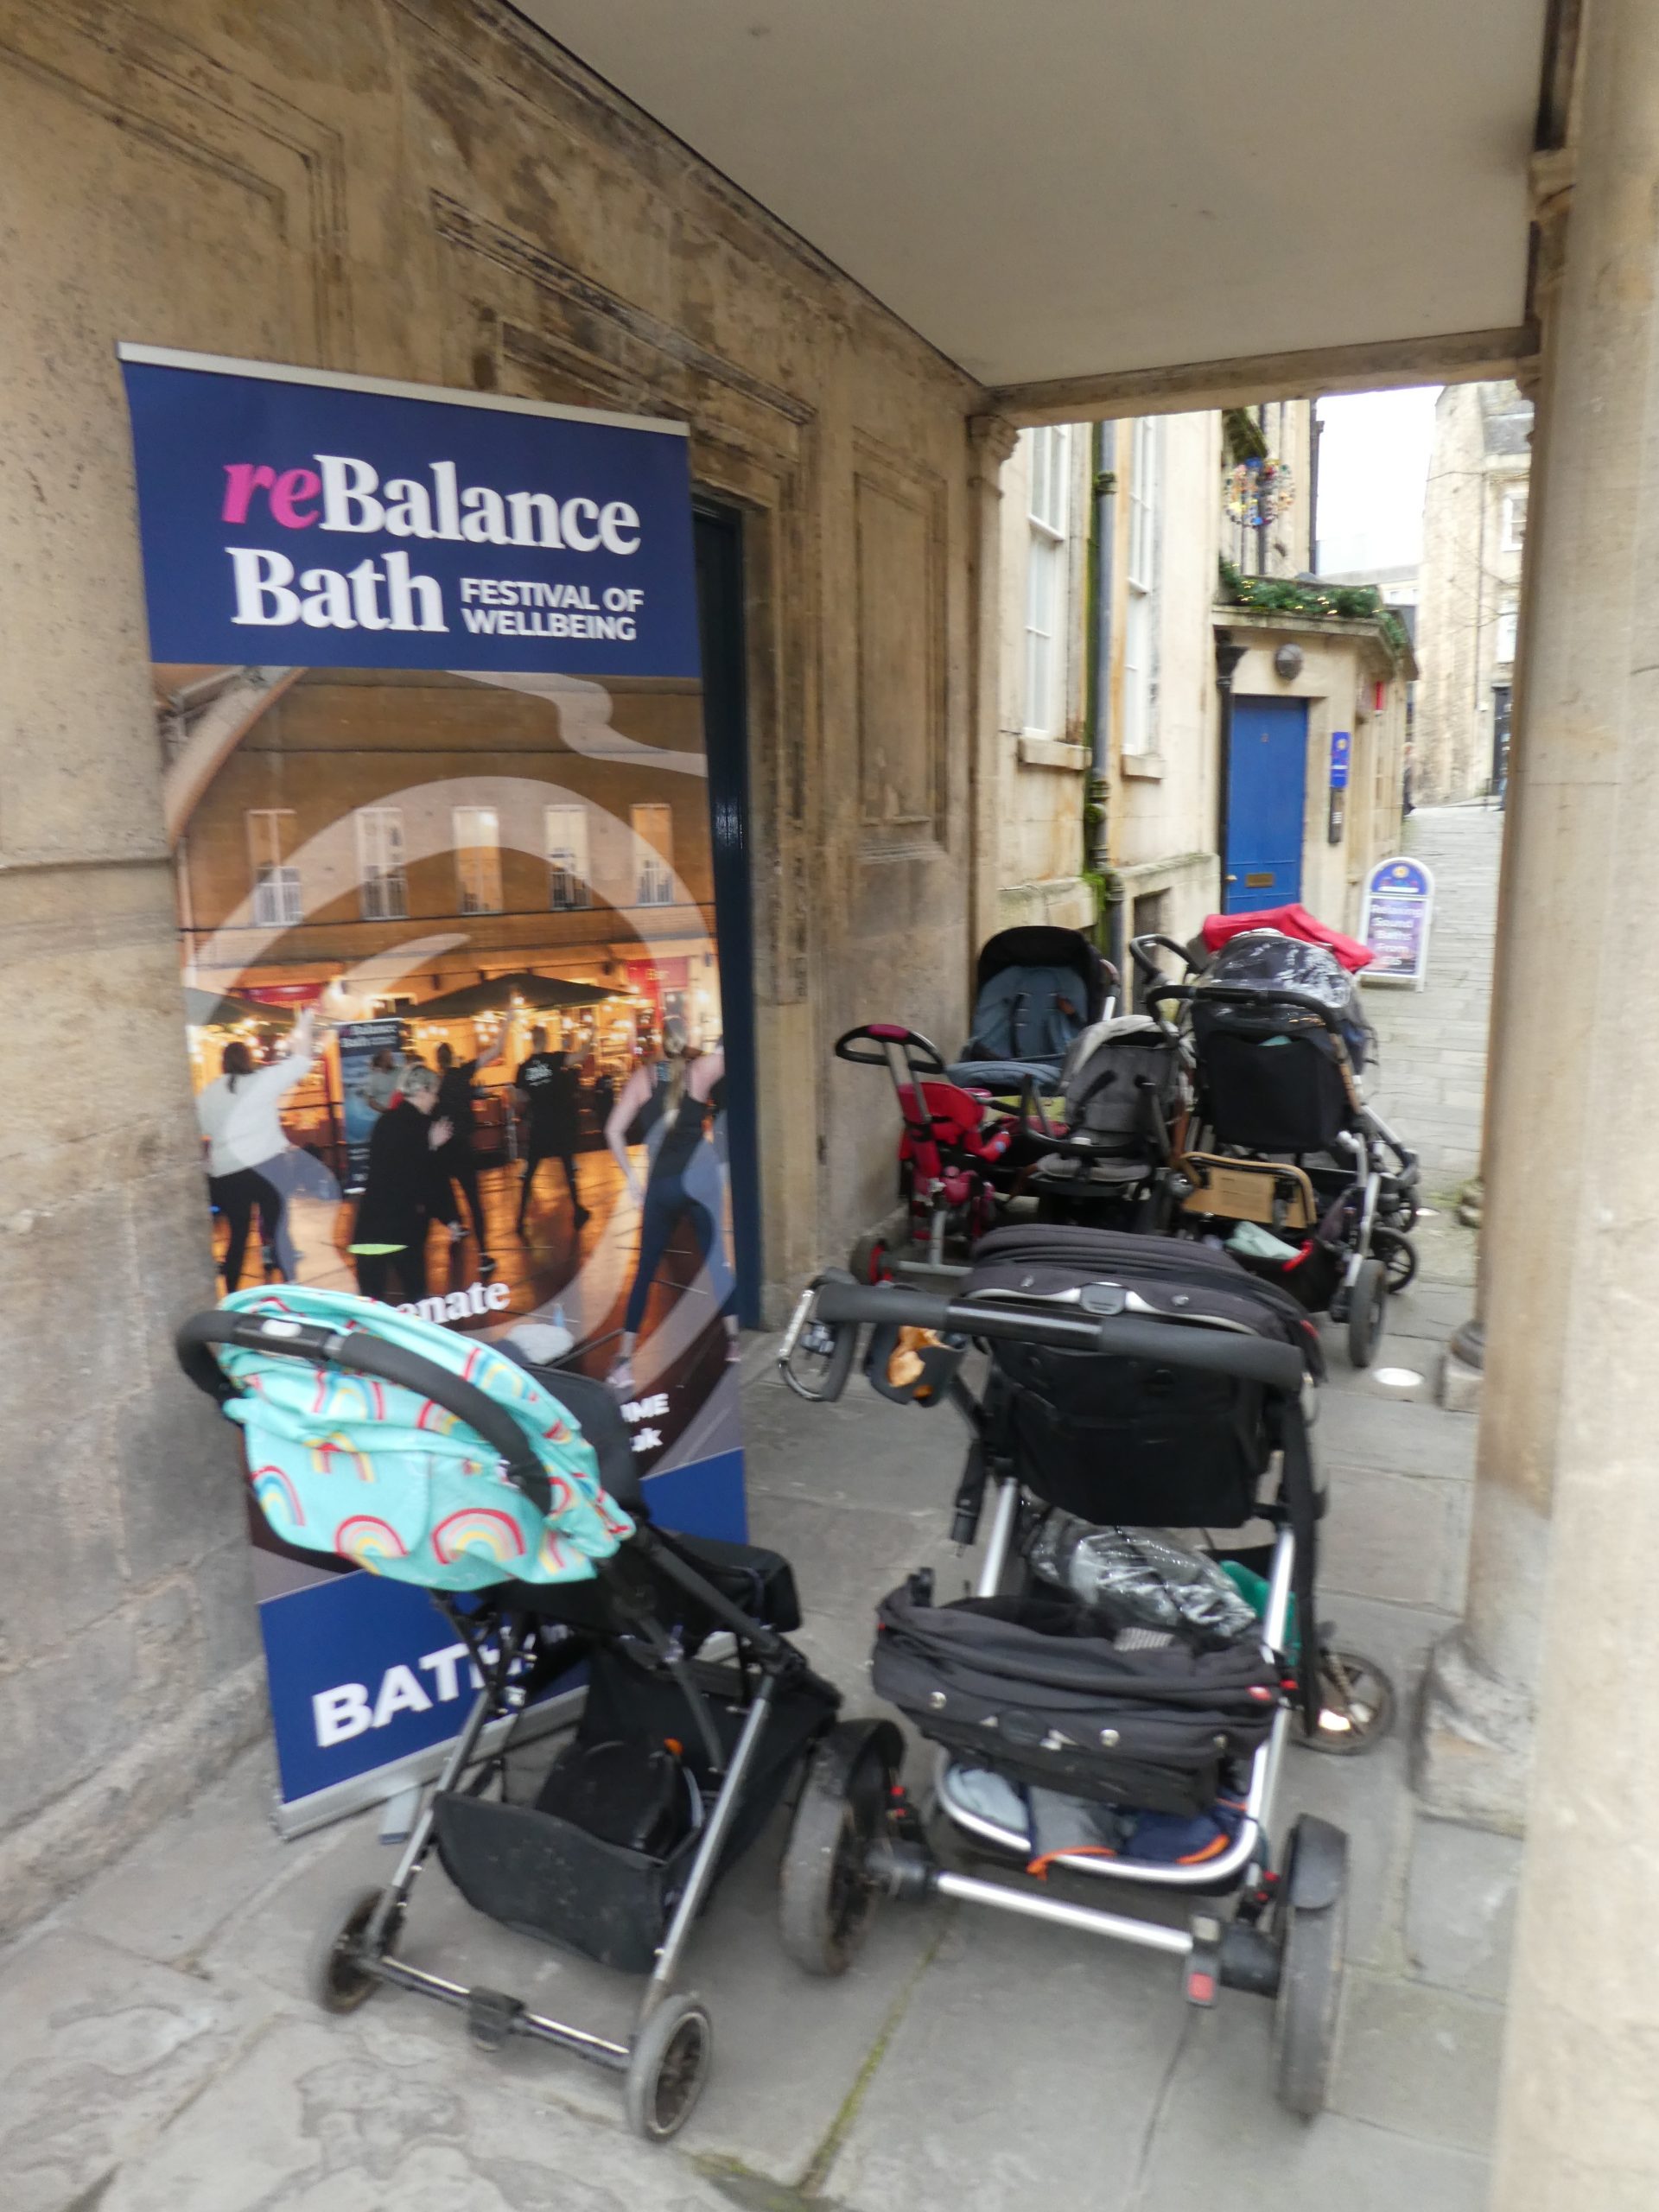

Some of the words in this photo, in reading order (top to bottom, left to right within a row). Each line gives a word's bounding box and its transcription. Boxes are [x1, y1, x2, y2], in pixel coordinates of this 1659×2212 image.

[221, 454, 641, 555] reBalance
[224, 547, 449, 632] Bath
[460, 577, 598, 610] FESTIVAL
[604, 588, 644, 613] OF
[461, 608, 636, 641] WELLBEING
